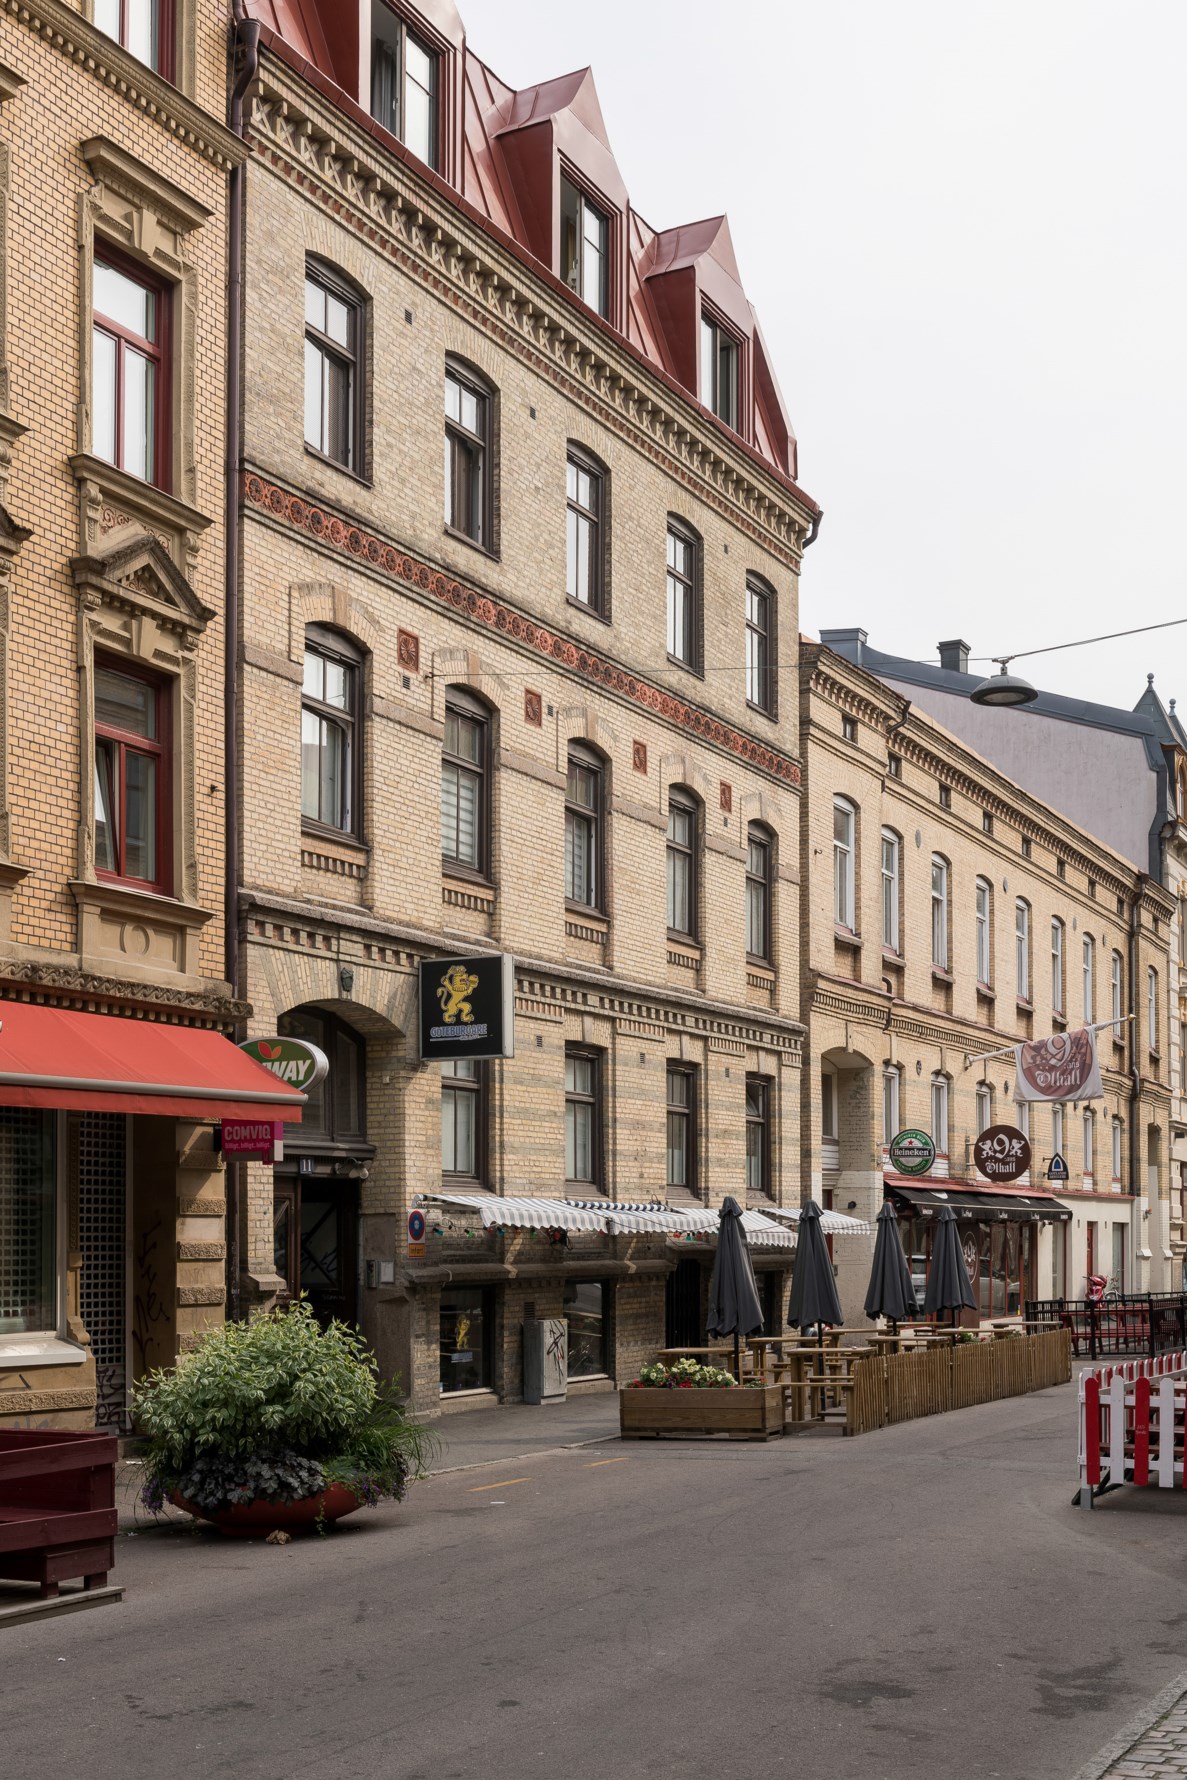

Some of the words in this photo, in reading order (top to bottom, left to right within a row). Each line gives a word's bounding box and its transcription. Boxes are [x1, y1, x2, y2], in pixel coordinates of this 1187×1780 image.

[1035, 1066, 1081, 1087] Ölhall
[224, 1125, 271, 1141] COMVIQ
[893, 1148, 930, 1156] Heineken
[993, 1133, 1010, 1159] 9
[302, 1158, 312, 1172] 11
[985, 1159, 1016, 1173] Ölhall
